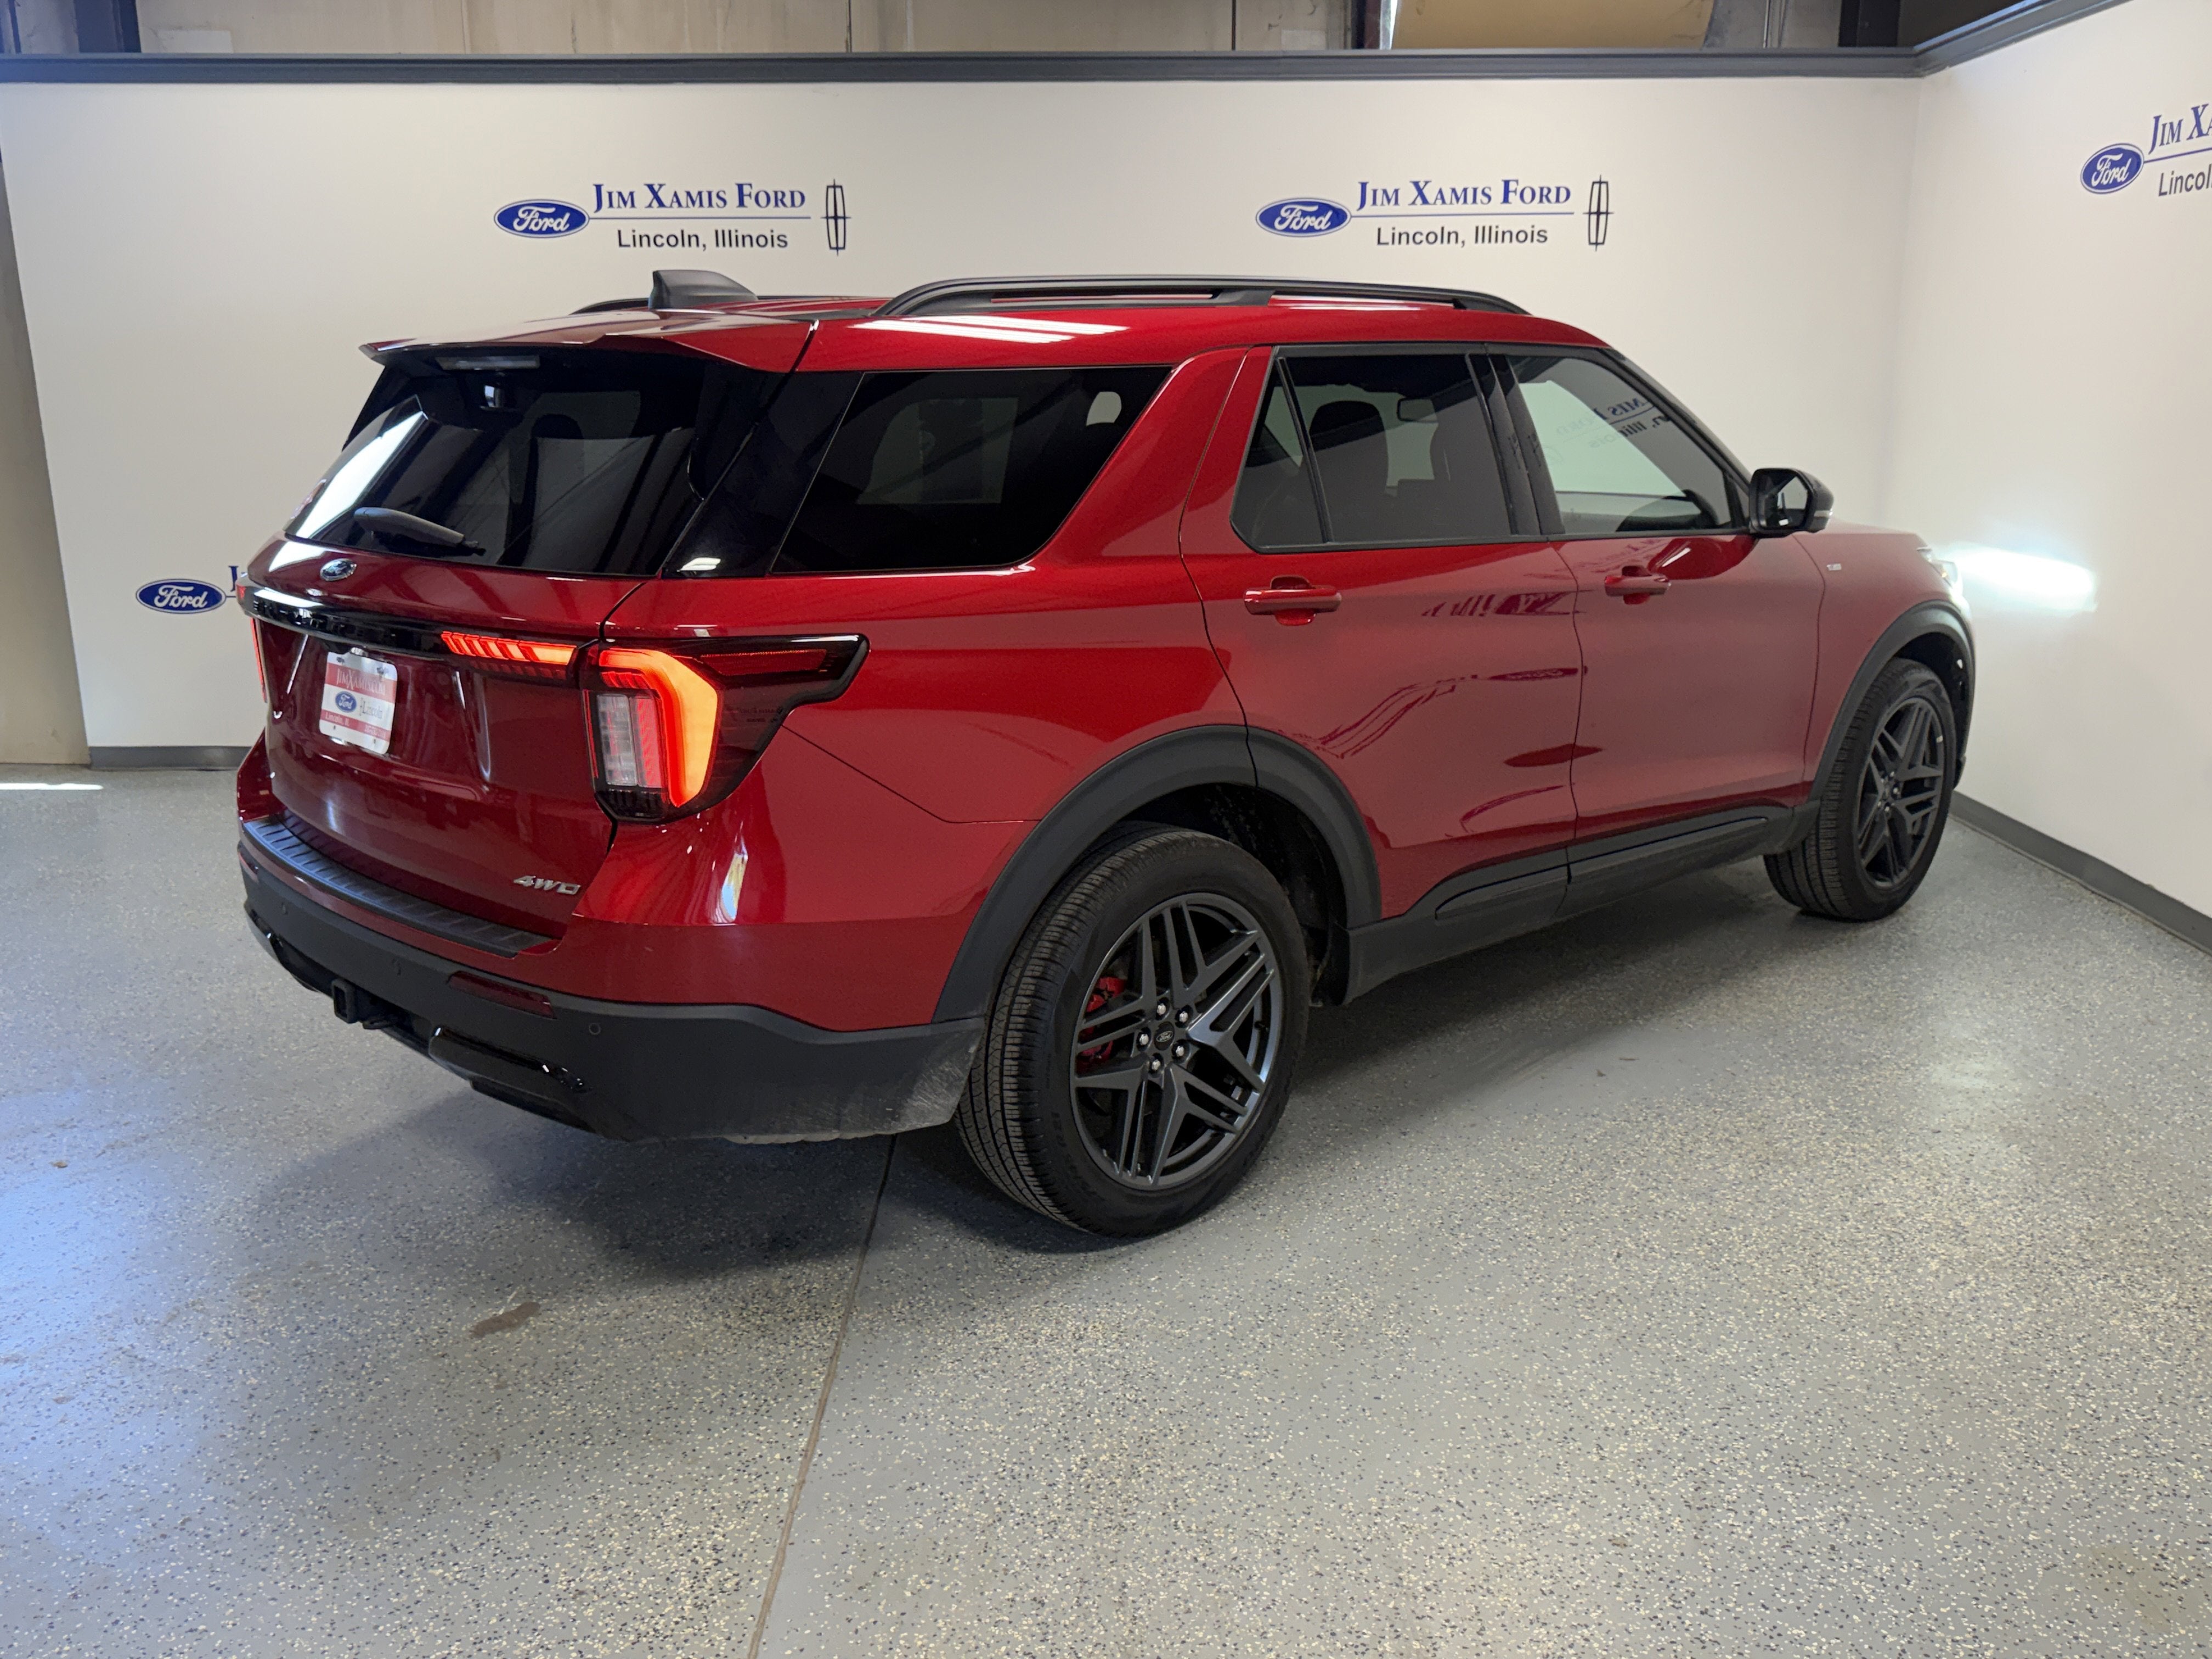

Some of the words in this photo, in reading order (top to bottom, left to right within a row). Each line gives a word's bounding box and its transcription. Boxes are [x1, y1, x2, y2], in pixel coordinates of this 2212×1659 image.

[2148, 115, 2183, 155] JIM
[2091, 153, 2132, 187] Ford
[2158, 163, 2212, 197] Lincol
[592, 184, 636, 213] JIM
[644, 184, 727, 208] XAMIS
[735, 183, 805, 208] FORD
[1357, 182, 1400, 211] JIM
[1408, 180, 1492, 206] XAMIS
[1500, 179, 1571, 204] FORD
[513, 206, 571, 232] Ford
[1274, 204, 1333, 230] Ford
[618, 229, 706, 251] Lincoln,
[715, 229, 788, 248] Illinois
[1377, 226, 1465, 247] Lincoln,
[1475, 225, 1548, 244] Illinois
[154, 584, 208, 608] Ford
[514, 876, 581, 895] 4WD
